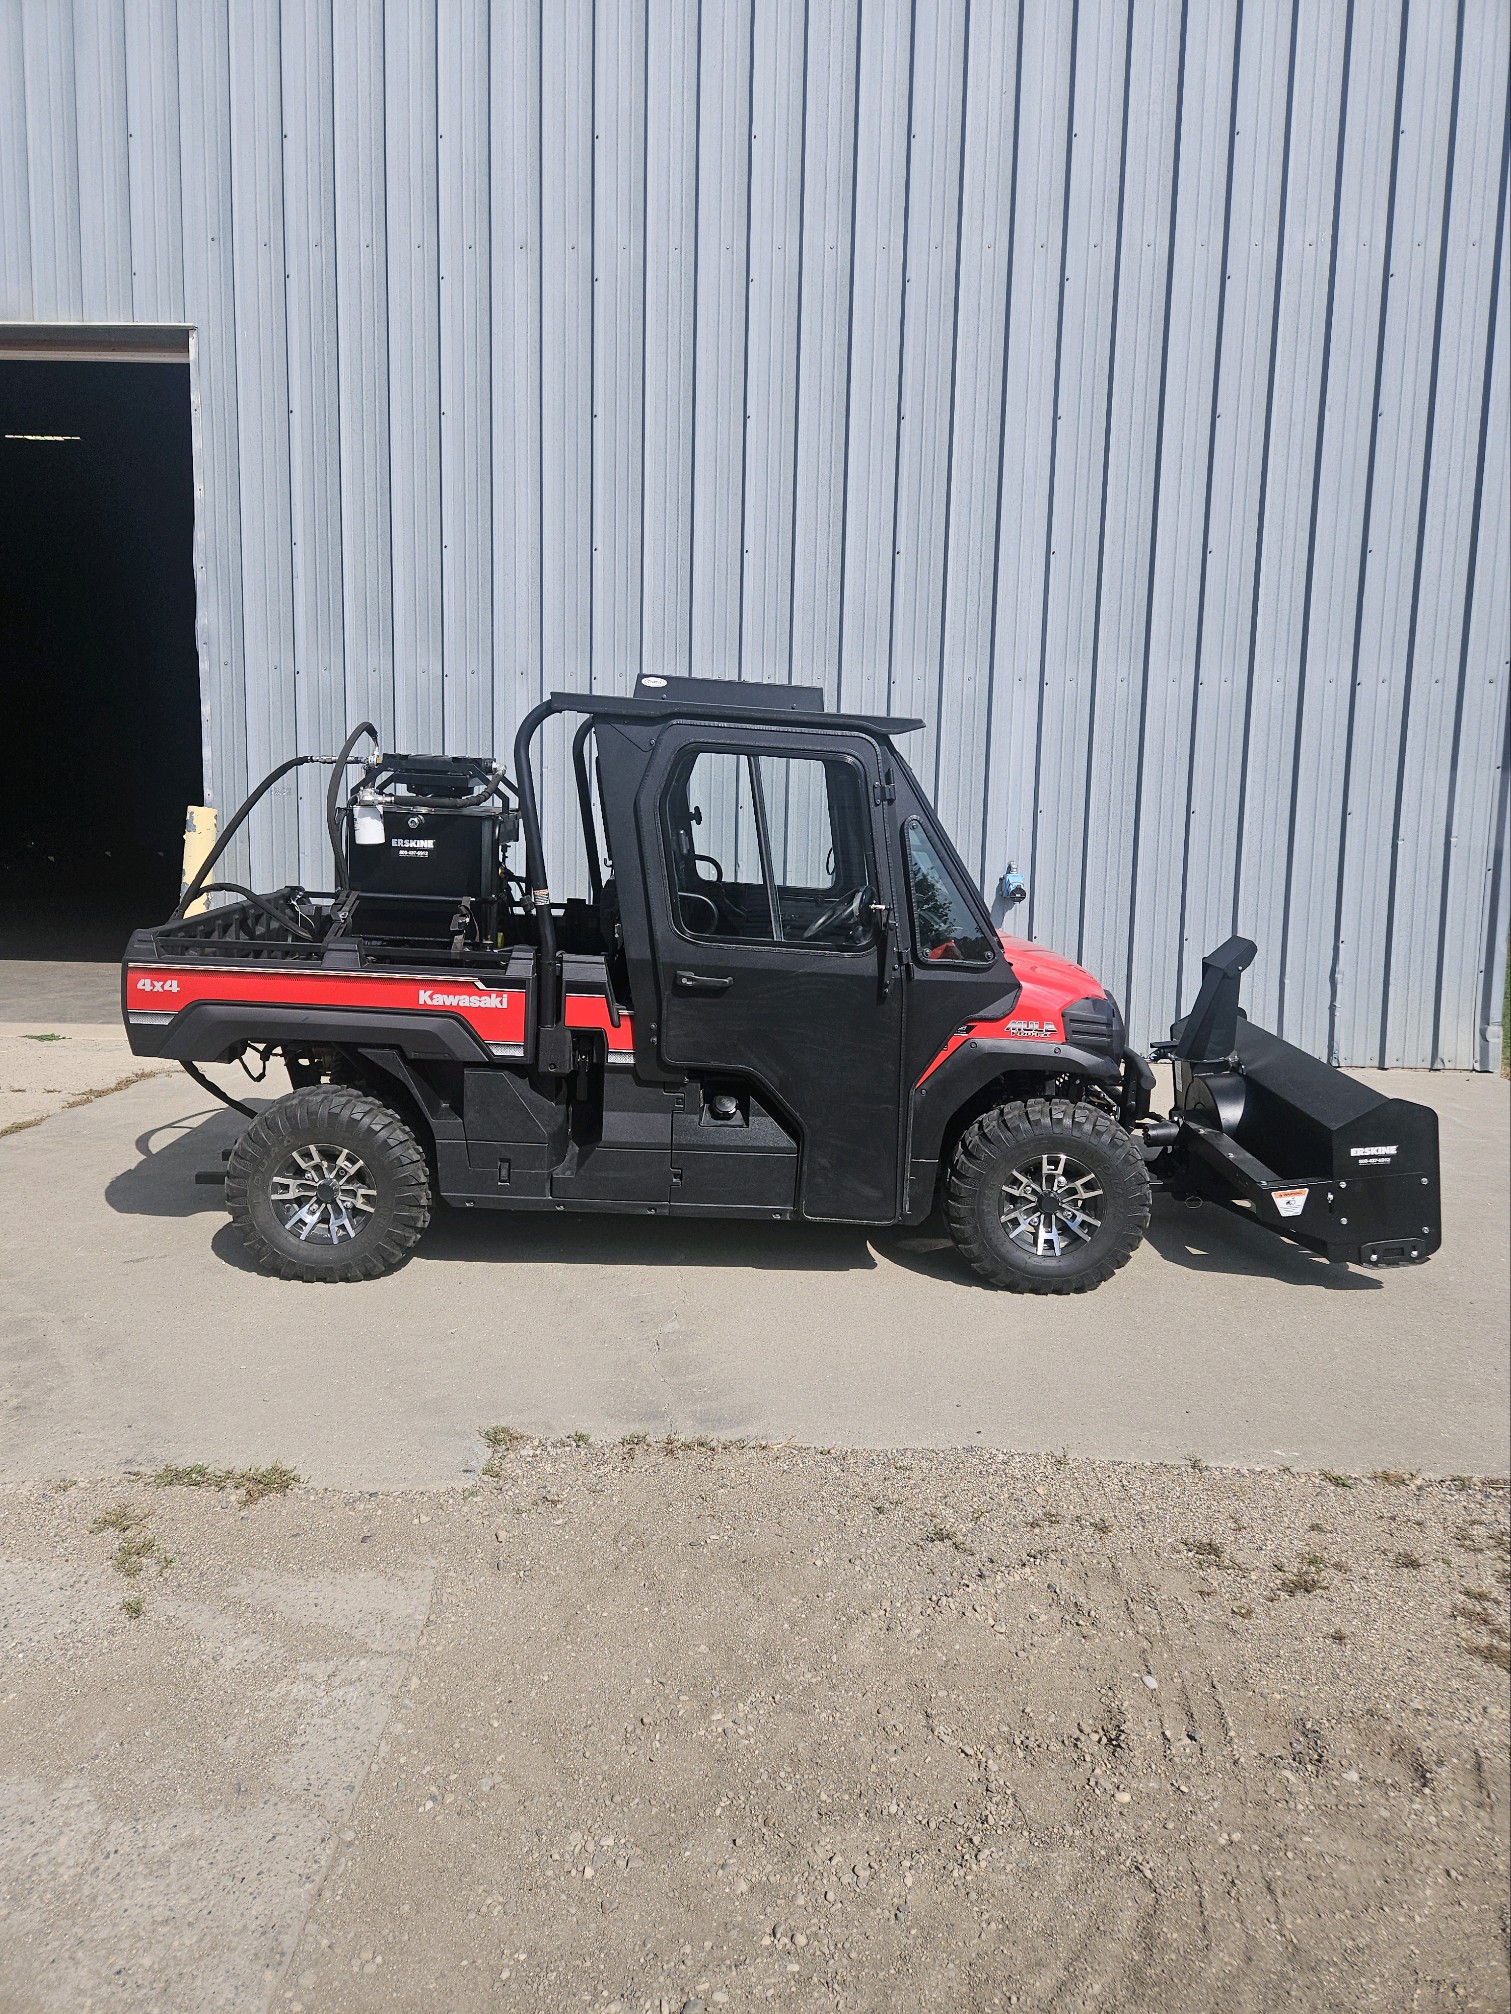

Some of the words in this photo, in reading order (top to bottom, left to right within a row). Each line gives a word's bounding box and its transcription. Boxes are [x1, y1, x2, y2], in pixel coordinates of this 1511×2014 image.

[391, 838, 435, 849] ERSKINE
[136, 978, 181, 993] 4x4
[418, 989, 508, 1009] Kawasaki
[1004, 1020, 1059, 1033] MULE
[1350, 1145, 1399, 1157] ERSKINE
